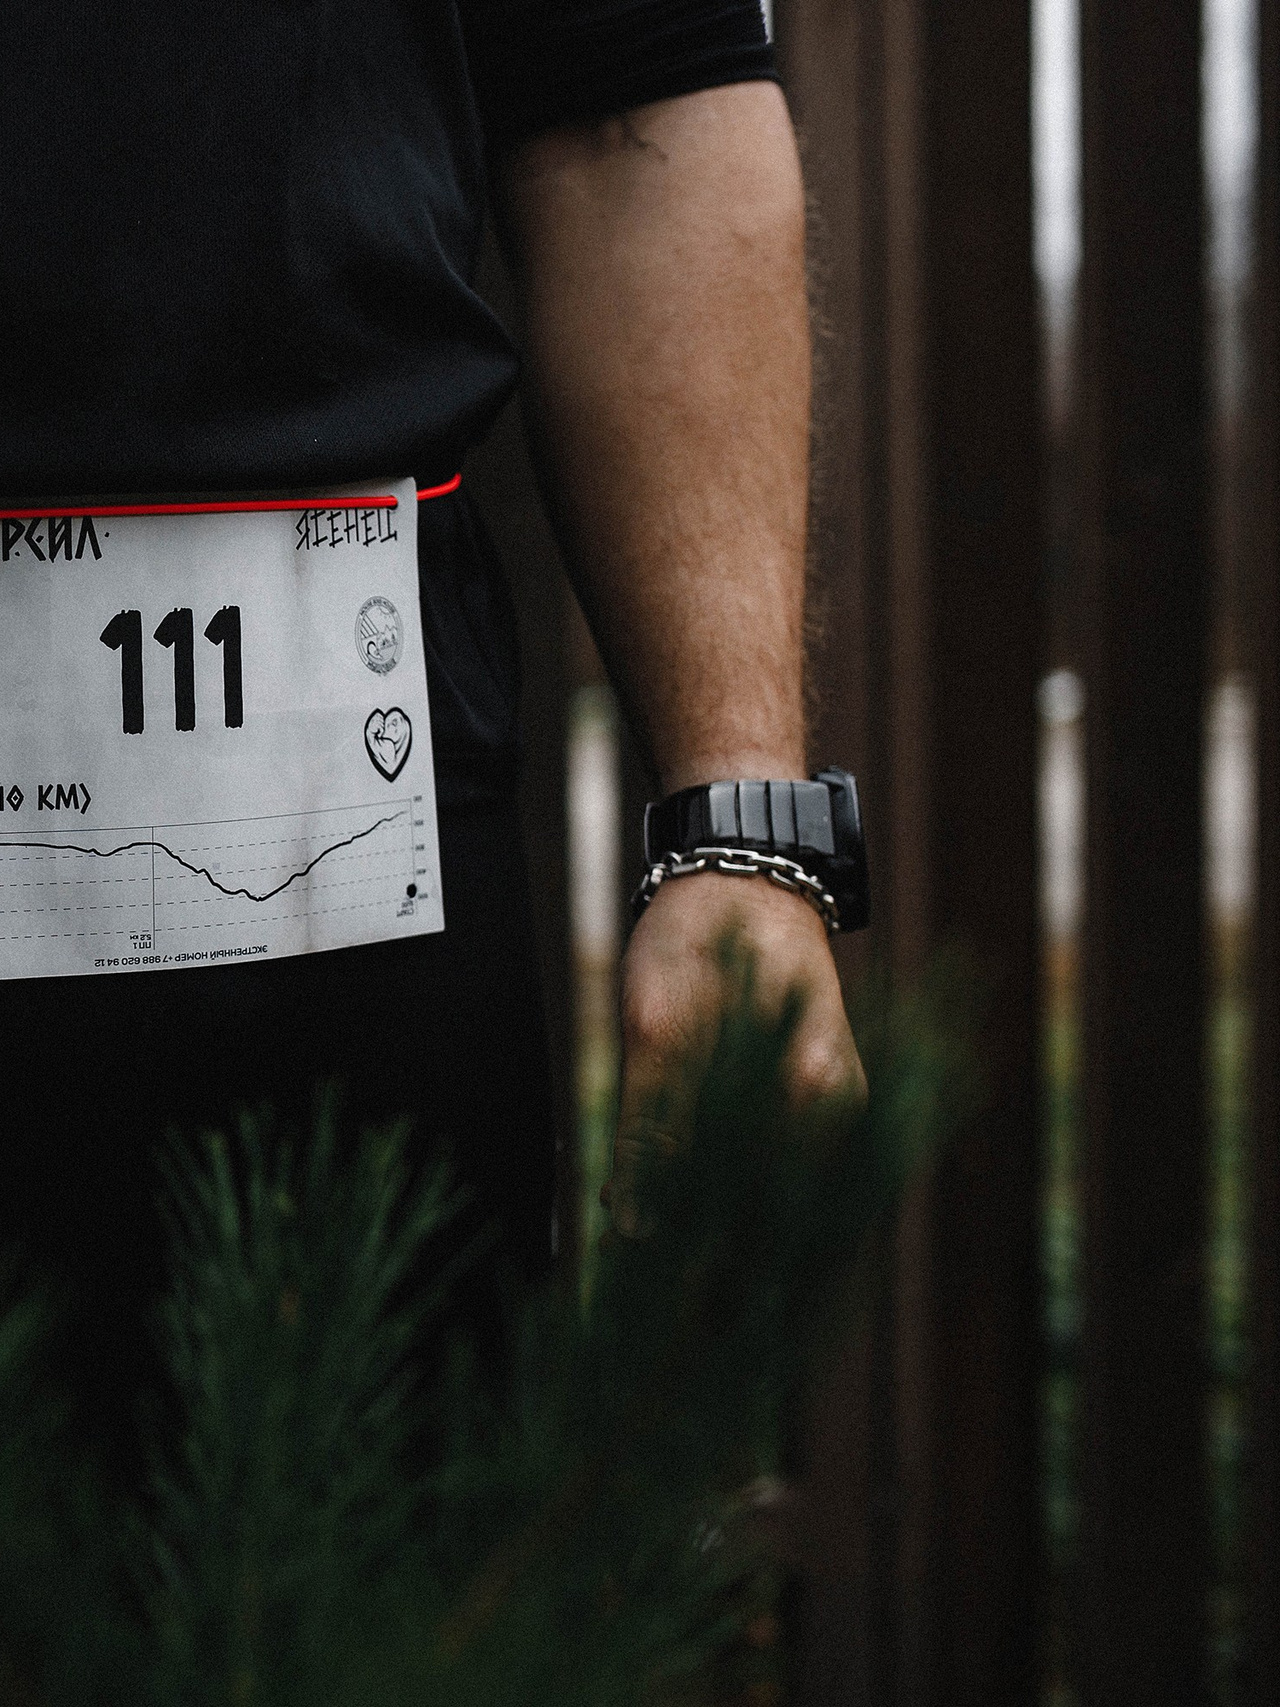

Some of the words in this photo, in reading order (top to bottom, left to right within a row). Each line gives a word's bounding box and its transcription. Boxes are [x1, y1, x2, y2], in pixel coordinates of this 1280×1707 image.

[99, 605, 244, 735] 111
[138, 941, 152, 949] ПП
[174, 951, 209, 962] НОМЕР
[209, 944, 269, 961] ЭКСТРЕННЫЙ
[94, 959, 106, 967] 12
[107, 958, 120, 967] 94
[121, 957, 141, 966] 620
[142, 955, 161, 964] 988
[162, 955, 173, 964] +7
